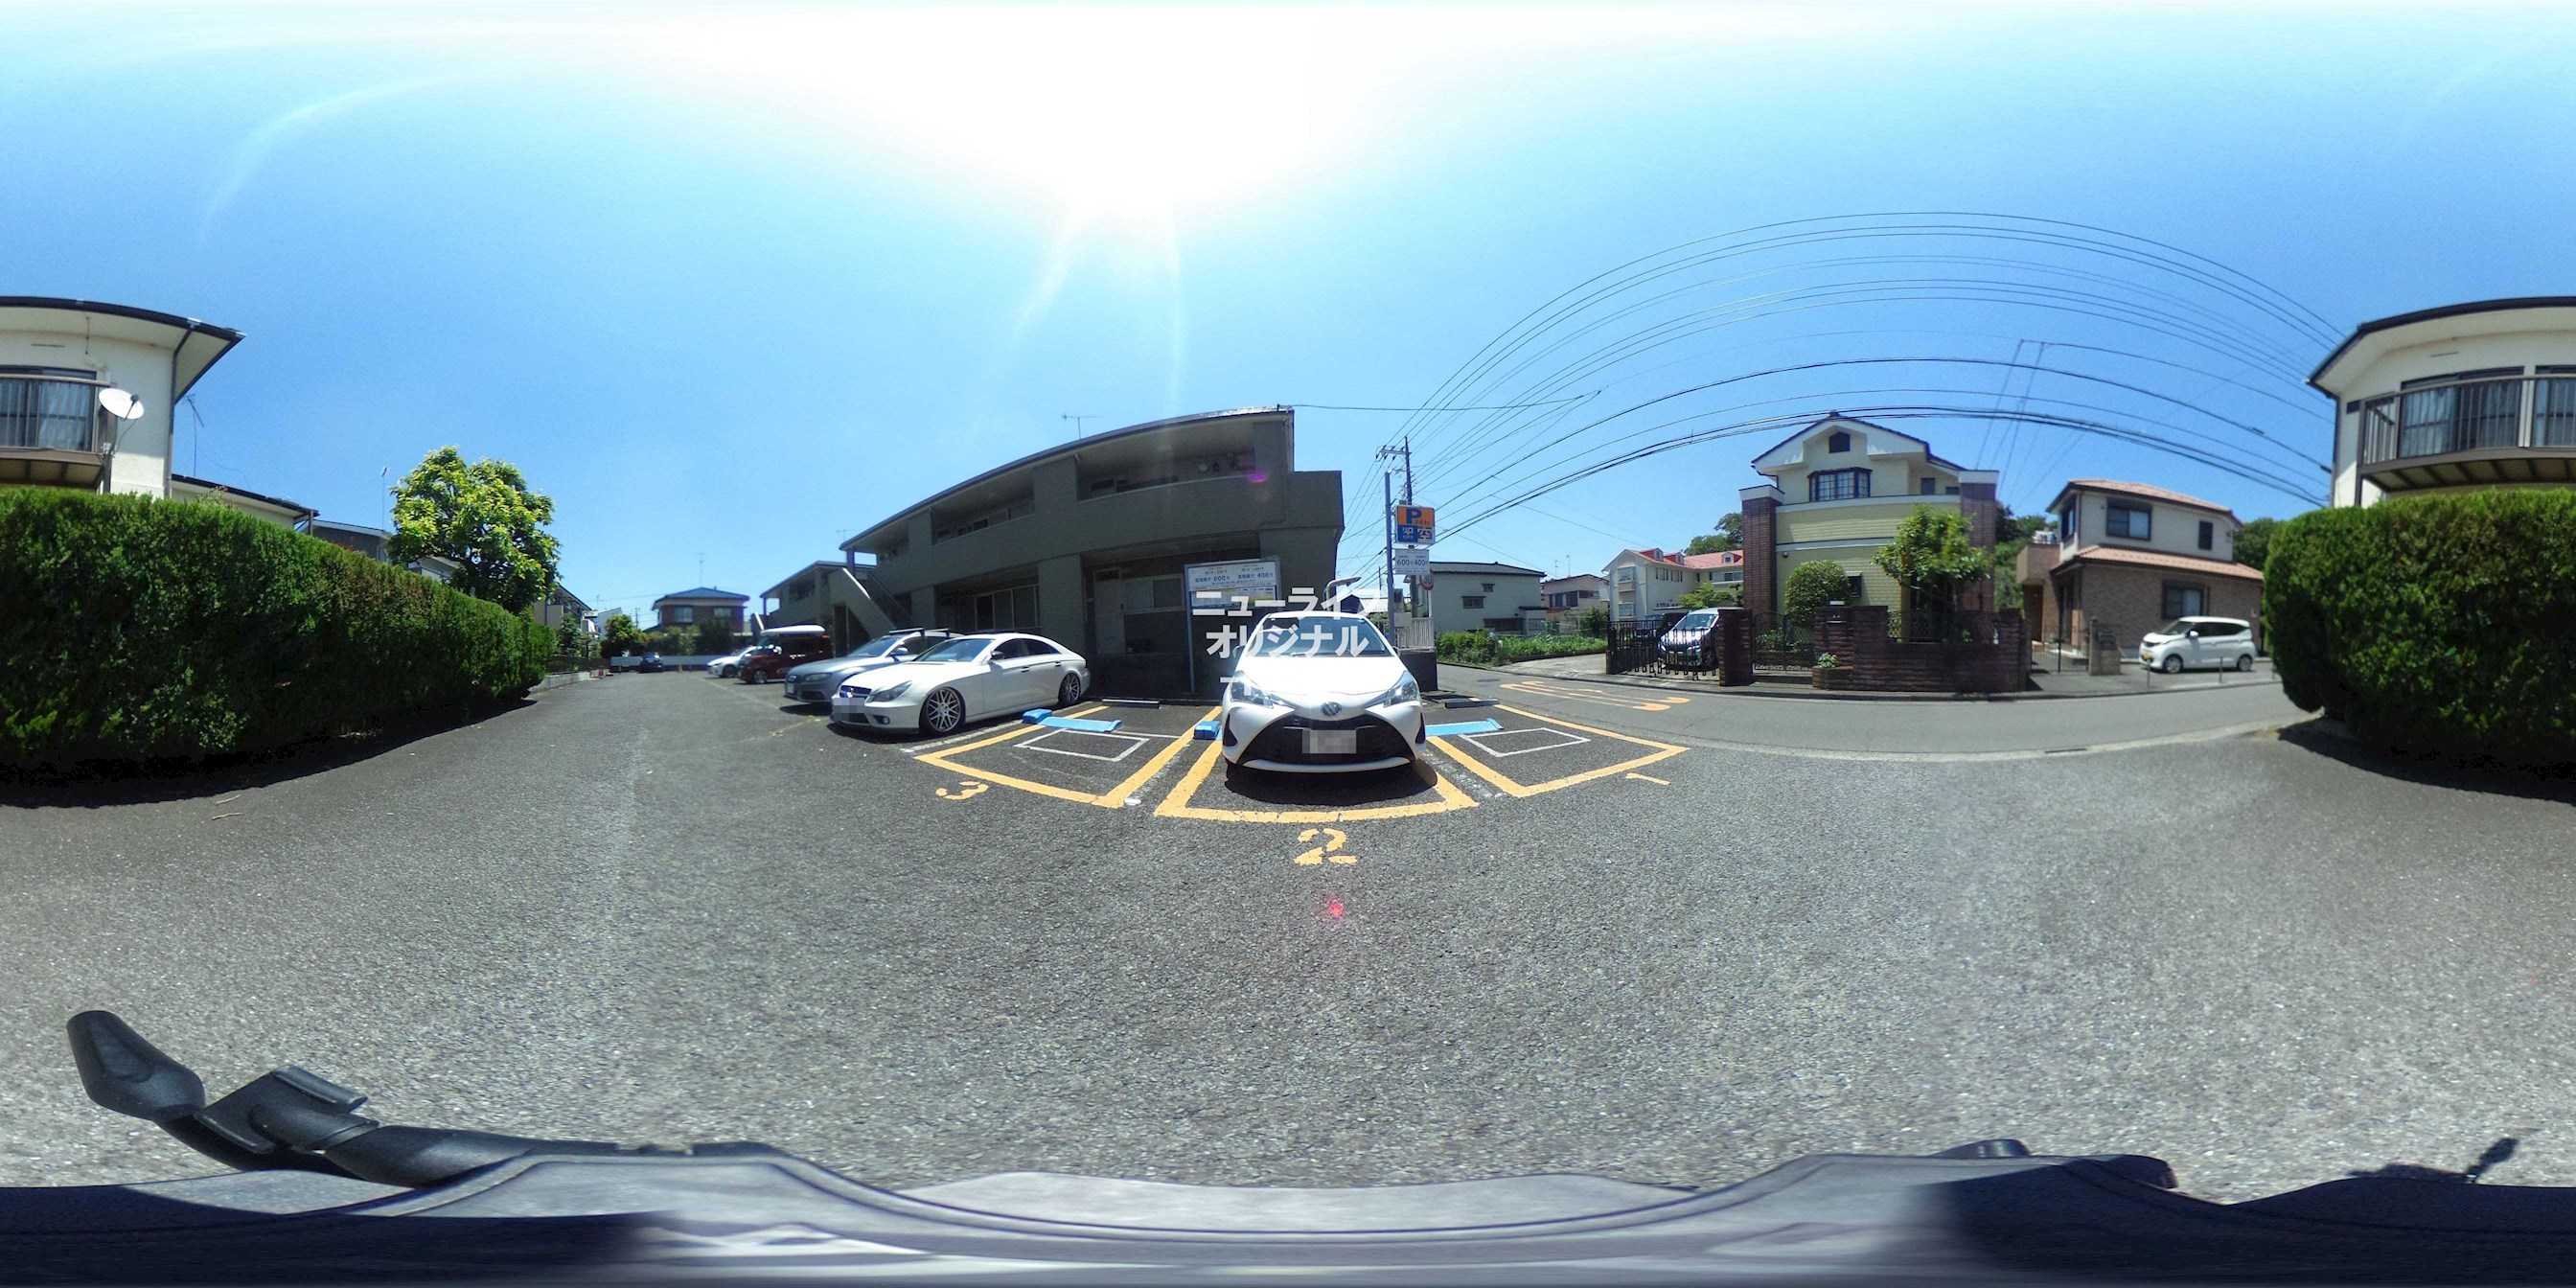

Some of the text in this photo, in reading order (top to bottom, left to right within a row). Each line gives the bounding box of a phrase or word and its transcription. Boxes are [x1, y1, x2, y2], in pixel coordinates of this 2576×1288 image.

[1407, 508, 1422, 525] P
[935, 780, 989, 799] 3
[1293, 827, 1358, 865] 2
